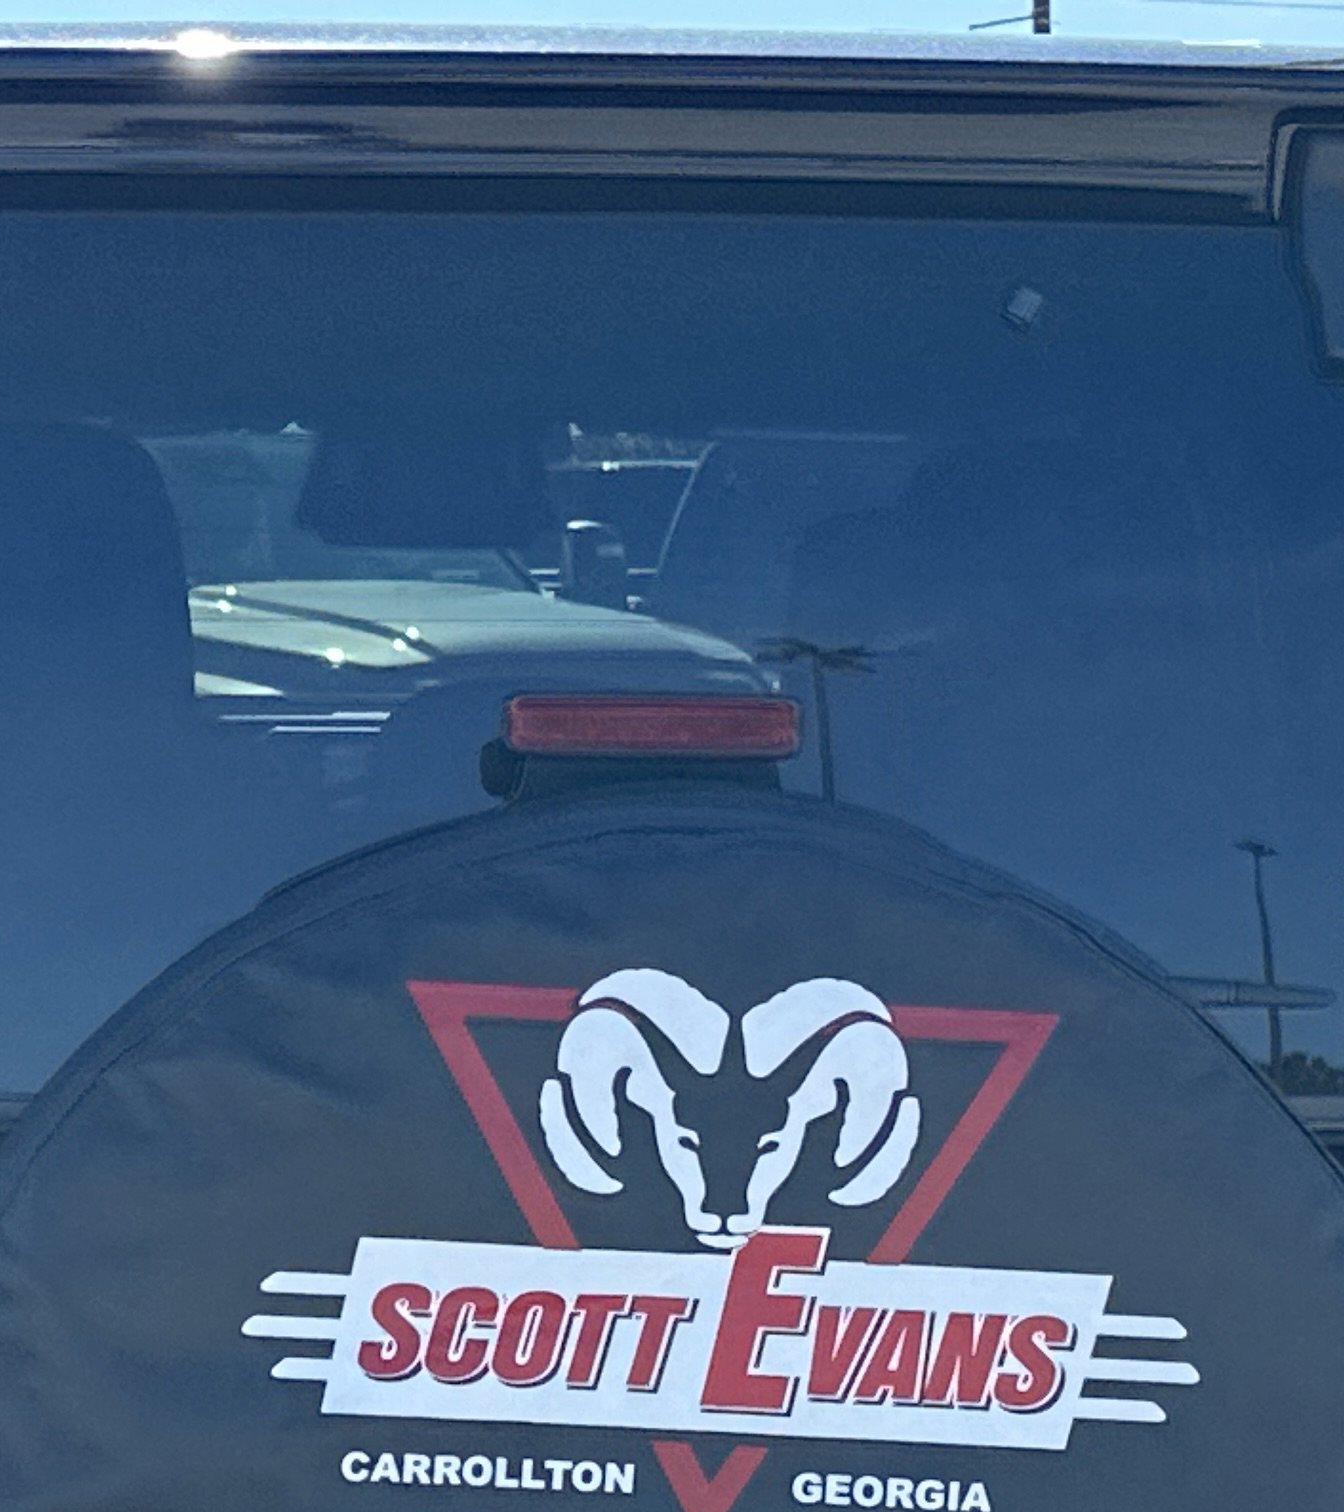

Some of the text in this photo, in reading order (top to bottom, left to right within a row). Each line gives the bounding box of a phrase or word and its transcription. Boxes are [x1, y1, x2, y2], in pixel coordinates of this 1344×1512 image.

[355, 1228, 1078, 1416] SCOTT EVANS
[340, 1450, 636, 1495] CARROLLTON
